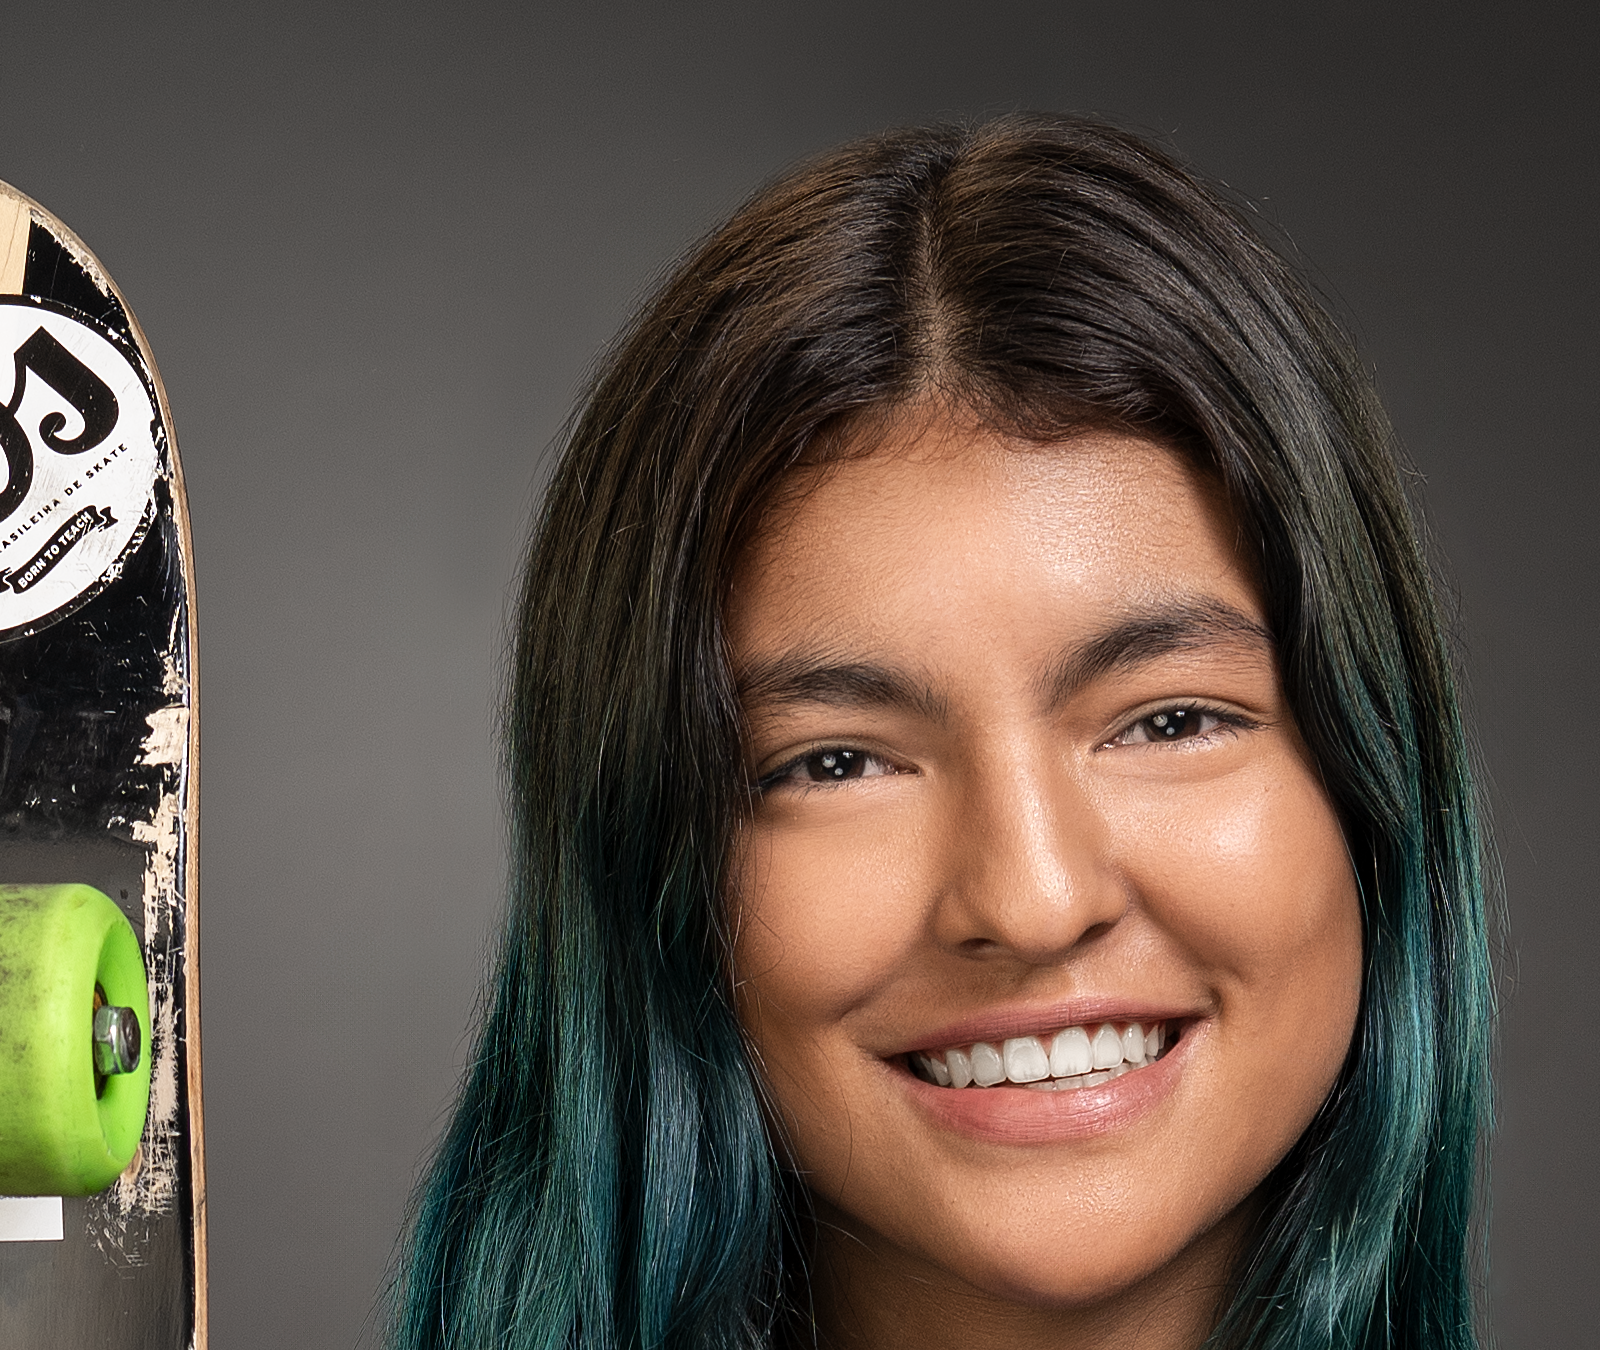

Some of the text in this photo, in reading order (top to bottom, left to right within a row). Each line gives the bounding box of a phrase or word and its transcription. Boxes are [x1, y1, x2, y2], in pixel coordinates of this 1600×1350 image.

[64, 479, 83, 497] DE
[85, 443, 128, 479] SKATE
[17, 511, 94, 588] BORN TO TEACH
